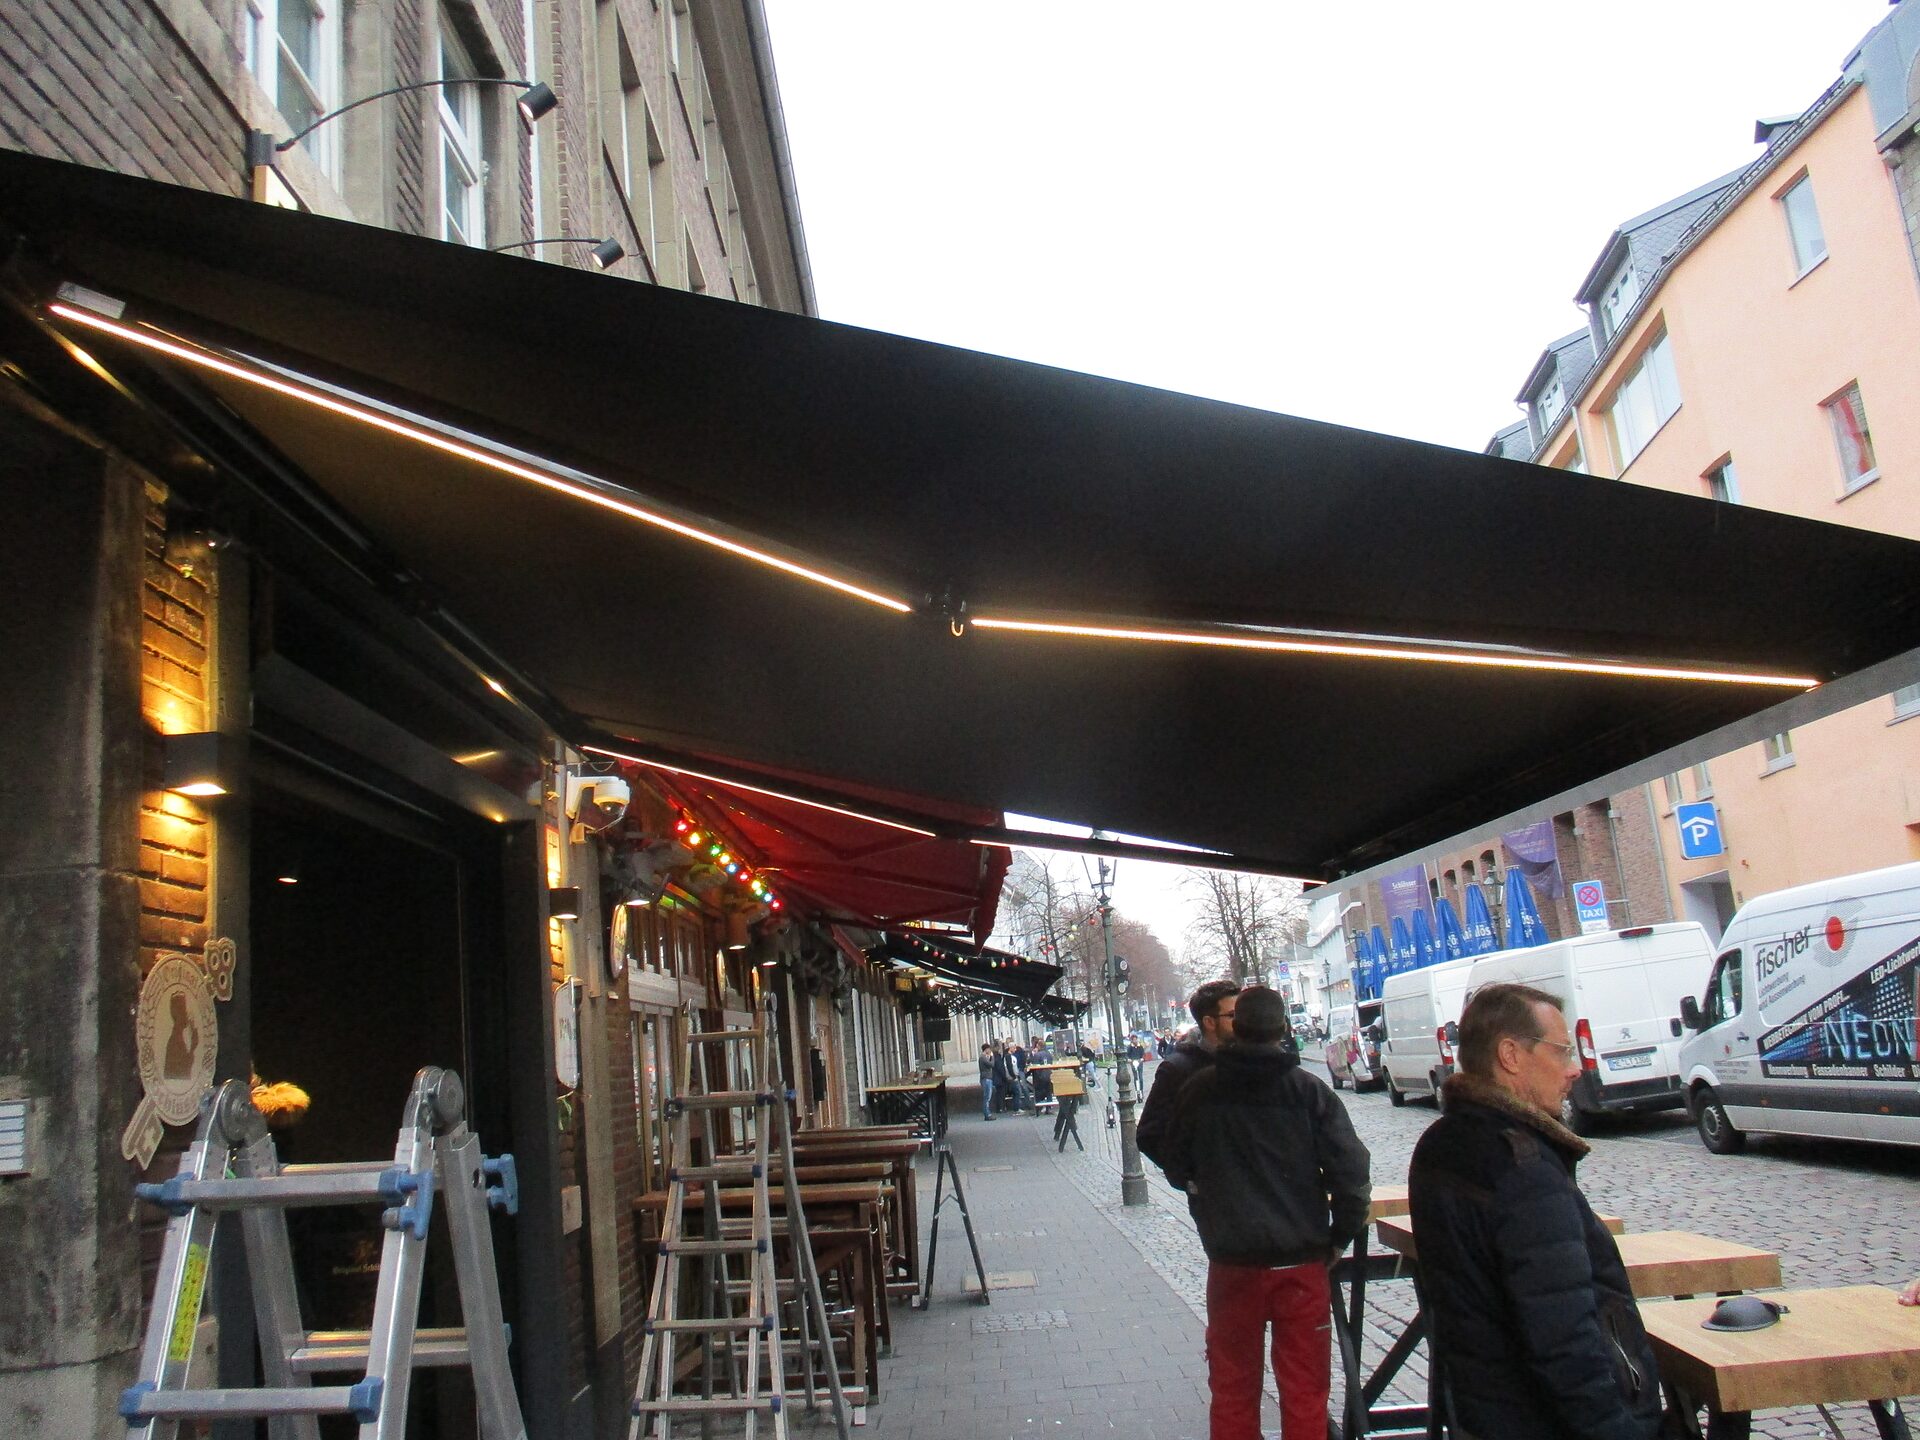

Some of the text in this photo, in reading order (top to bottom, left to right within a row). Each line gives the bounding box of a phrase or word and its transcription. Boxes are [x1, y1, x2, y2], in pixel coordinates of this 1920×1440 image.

[1691, 824, 1708, 846] P
[1581, 908, 1604, 919] TAXI
[1756, 924, 1811, 982] fischer
[1824, 1007, 1915, 1061] NEON
[1873, 1063, 1906, 1077] Schilder
